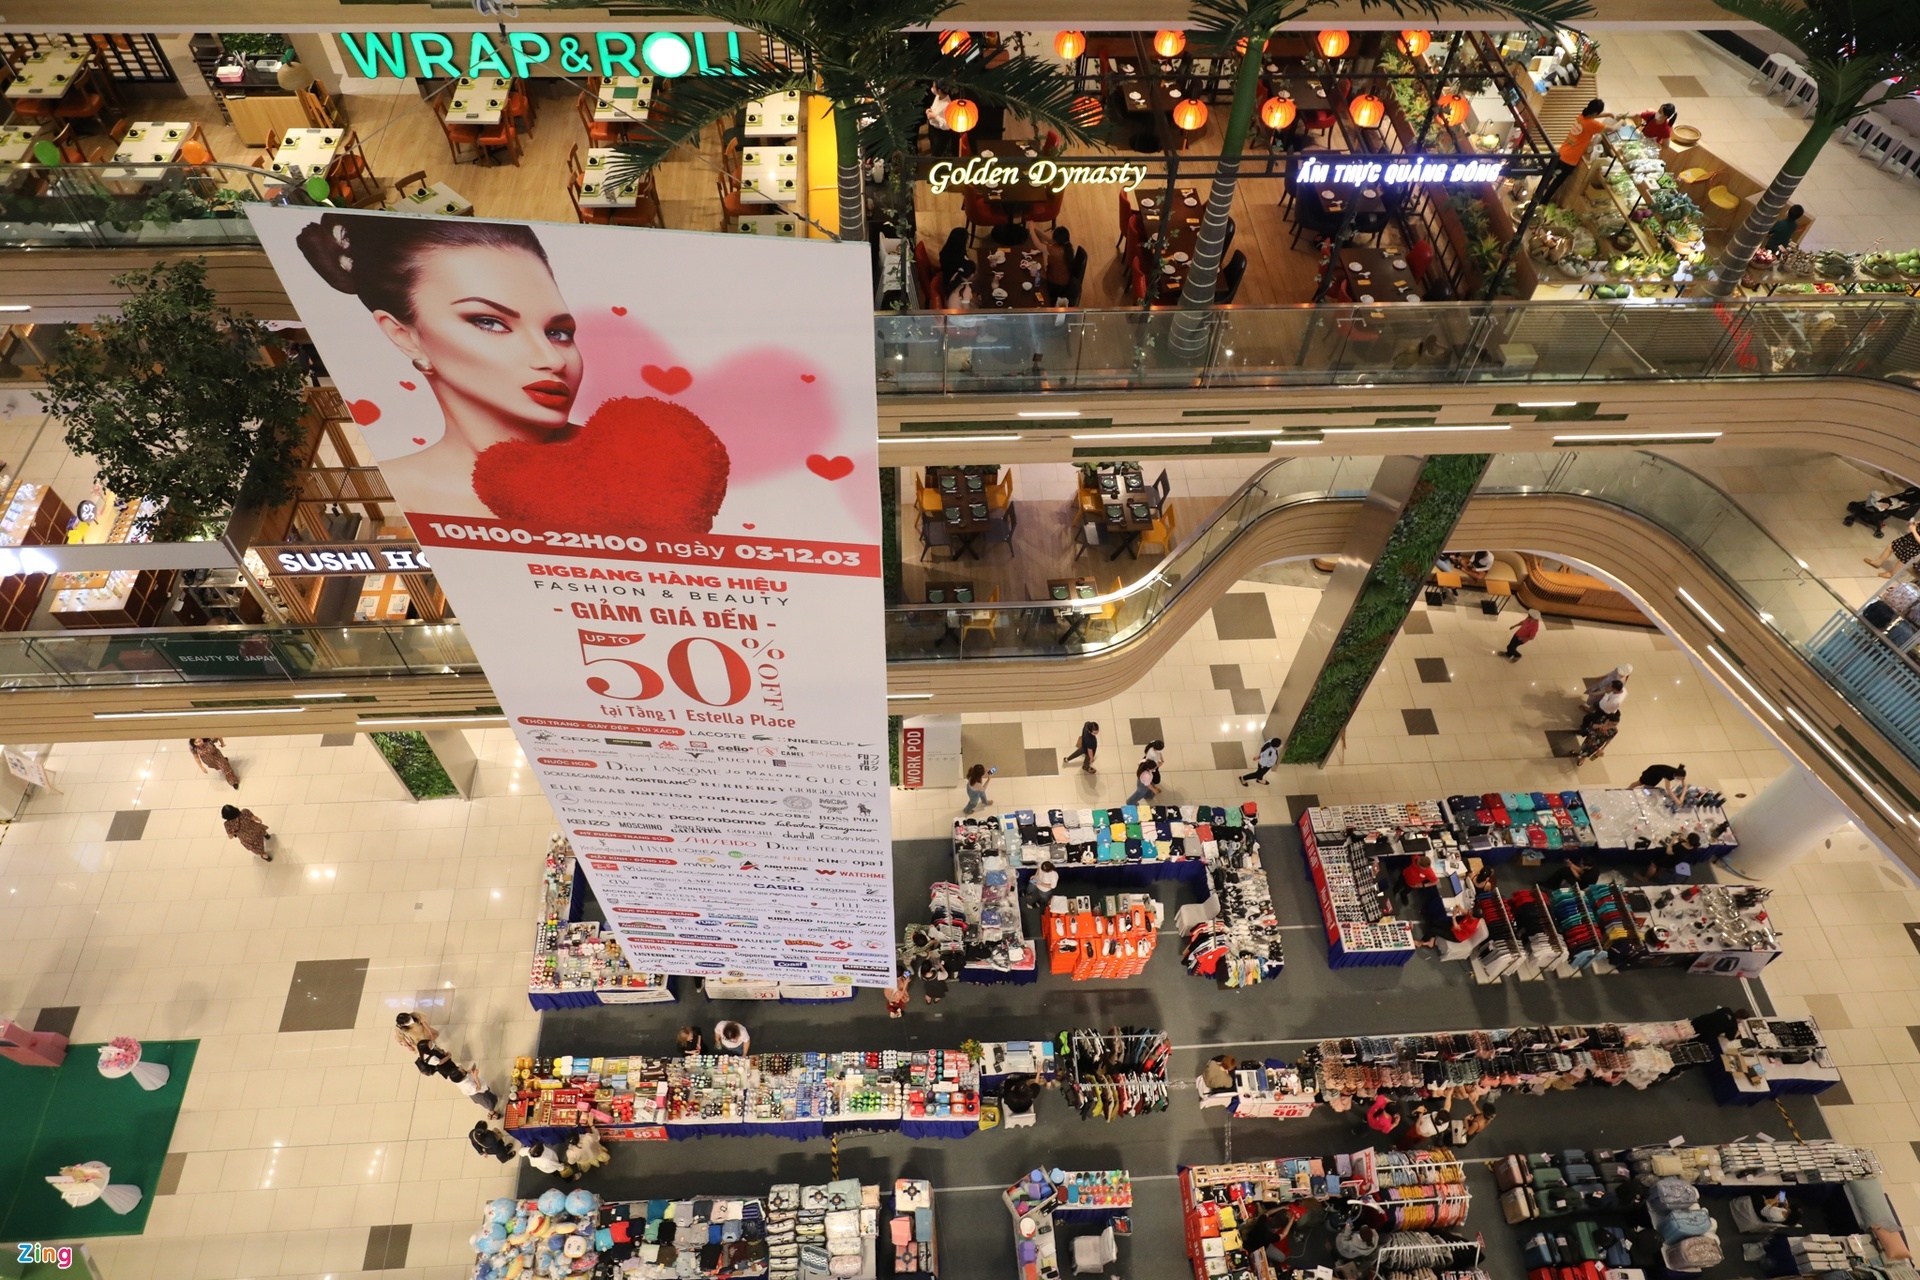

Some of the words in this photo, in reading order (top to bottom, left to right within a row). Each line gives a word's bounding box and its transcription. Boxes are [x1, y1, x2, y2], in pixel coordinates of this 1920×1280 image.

[929, 157, 1019, 195] Golden
[1028, 159, 1147, 193] Dynasty
[1333, 160, 1382, 187] THỰC
[1384, 157, 1448, 185] QUẢNG
[1450, 160, 1501, 182] ĐÔNG
[430, 522, 648, 553] 10H00-22H00
[656, 538, 726, 560] ngày
[735, 543, 861, 567] 03-12.03
[278, 552, 376, 572] SUSHI
[527, 563, 643, 584] BIGBANG
[650, 570, 722, 589] HÀNG
[729, 576, 788, 596] HIỆU
[534, 580, 646, 598] FASHION
[662, 589, 674, 599] &
[690, 592, 790, 607] BEAUTY
[571, 597, 643, 624] GIẢM
[651, 605, 693, 627] GIÁ
[703, 609, 758, 631] ĐẾN
[584, 633, 604, 645] UP
[606, 635, 631, 646] TO
[758, 663, 785, 711] OFF
[600, 705, 623, 718] tại
[626, 705, 667, 721] Tầng
[668, 709, 676, 720] 1
[686, 709, 744, 725] Estella
[750, 714, 796, 728] Place
[550, 720, 580, 728] TRANG
[561, 735, 601, 743] GEOX
[689, 730, 746, 740] LACOSTE
[907, 731, 921, 752] POD
[605, 761, 646, 773] Dior
[907, 755, 921, 785] WORK
[625, 777, 689, 786] MONTBLANC
[701, 782, 785, 792] BURBERRY
[806, 776, 877, 787] GUCCI
[589, 786, 626, 795] SAAB
[631, 790, 692, 799] narciso
[699, 793, 778, 805] rodriguez
[561, 807, 605, 815] ISSEY
[610, 810, 666, 820] MIYAKE
[760, 812, 811, 820] JACOBS
[567, 818, 611, 827] KENZO
[618, 821, 663, 831] MOSCHINO
[669, 814, 704, 822] paco
[708, 815, 766, 826] rabanne
[782, 830, 815, 840] dunhill
[820, 834, 853, 842] Calvin
[679, 836, 757, 848] SHISEIDO
[766, 841, 800, 851] Dior
[839, 871, 887, 879] WATCHME
[753, 883, 805, 892] CASIO
